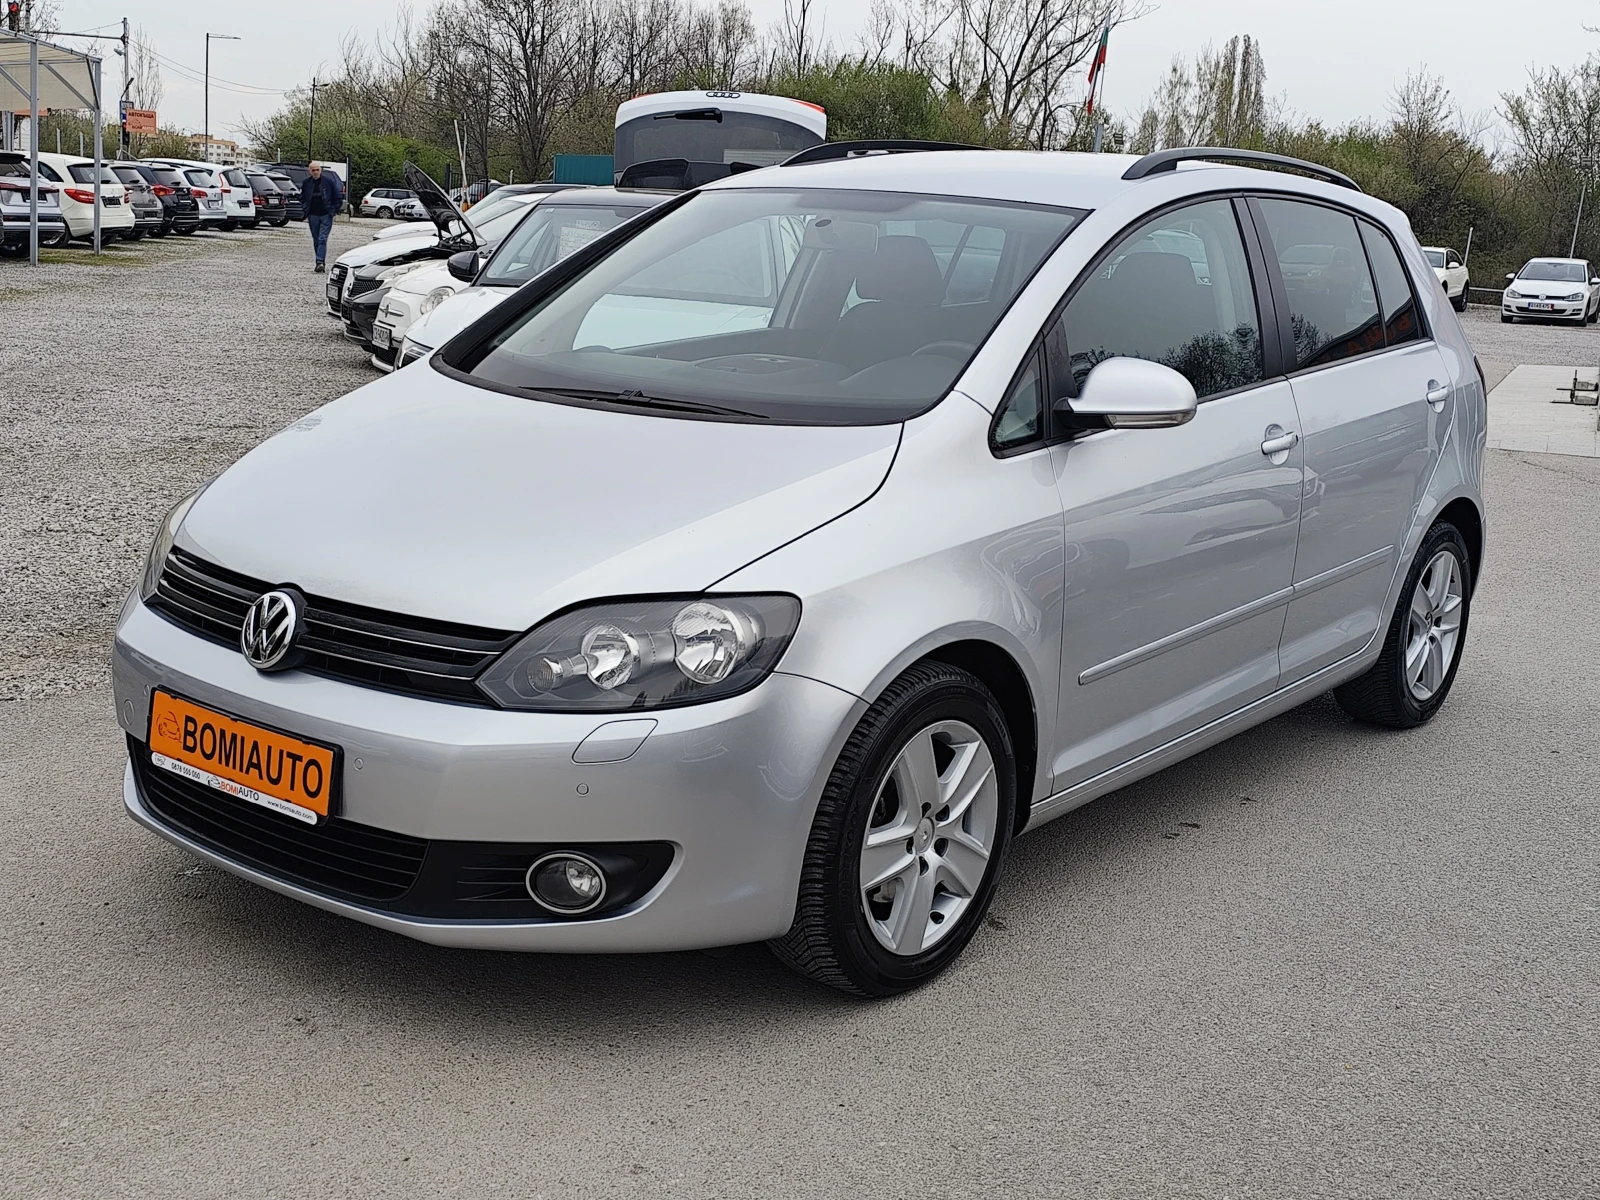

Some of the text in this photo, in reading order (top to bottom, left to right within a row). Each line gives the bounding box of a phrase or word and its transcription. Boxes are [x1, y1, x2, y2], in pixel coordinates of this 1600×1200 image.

[182, 714, 323, 799] BOMIAUTO
[171, 762, 200, 780] 0878 555 050
[220, 781, 260, 801] BOMIAUTO
[267, 799, 314, 821] www.bomiauto.com
